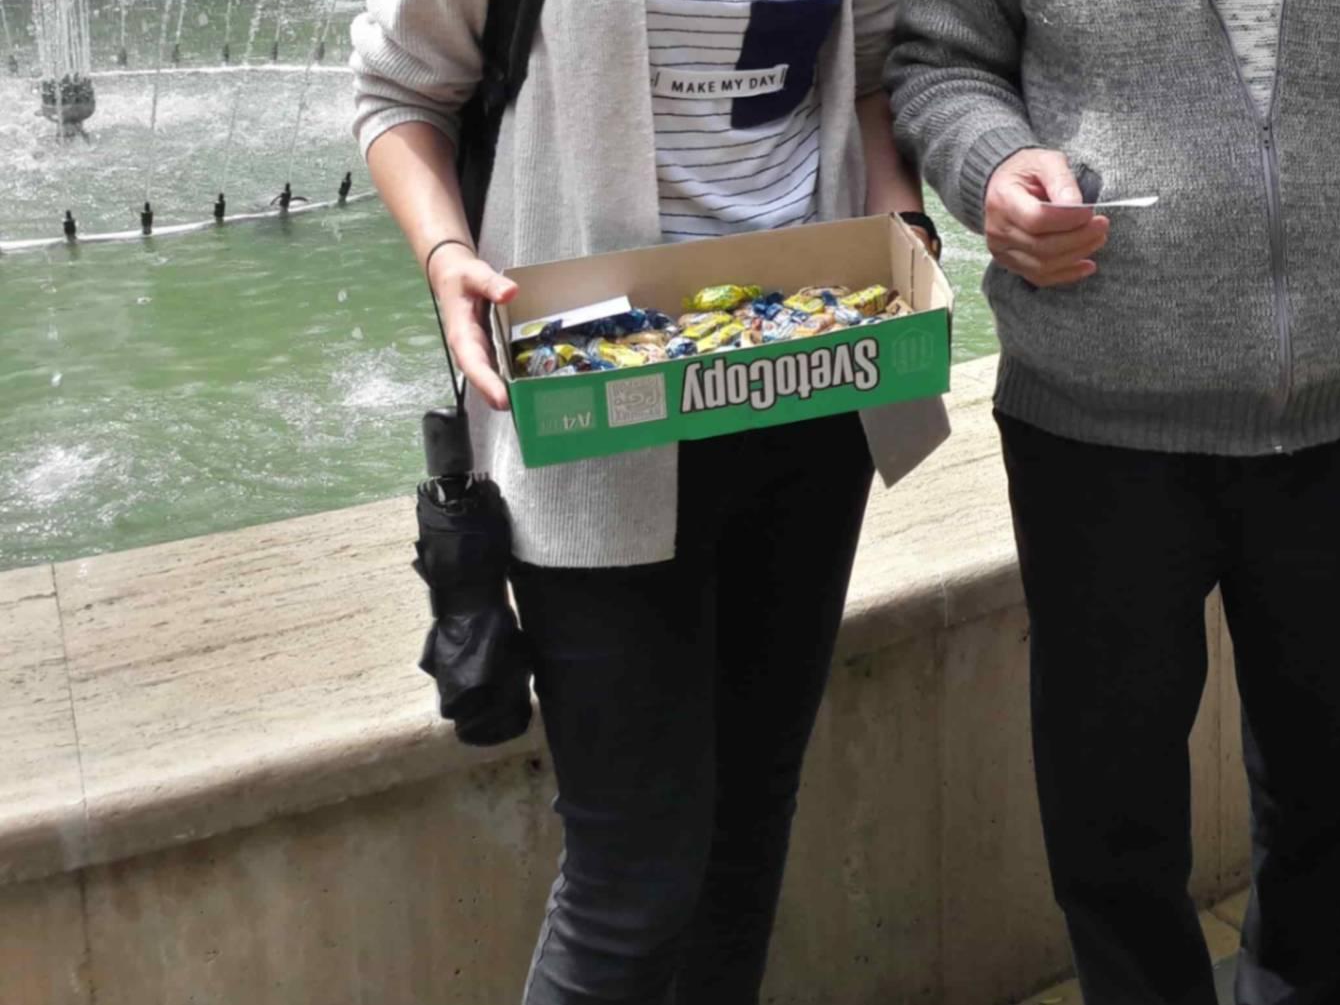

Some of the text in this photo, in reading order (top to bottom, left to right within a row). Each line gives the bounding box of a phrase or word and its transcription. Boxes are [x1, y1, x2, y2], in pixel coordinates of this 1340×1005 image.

[671, 74, 776, 94] MAKE MY DAY
[681, 337, 880, 414] SvetoCopy
[562, 411, 591, 430] A4
